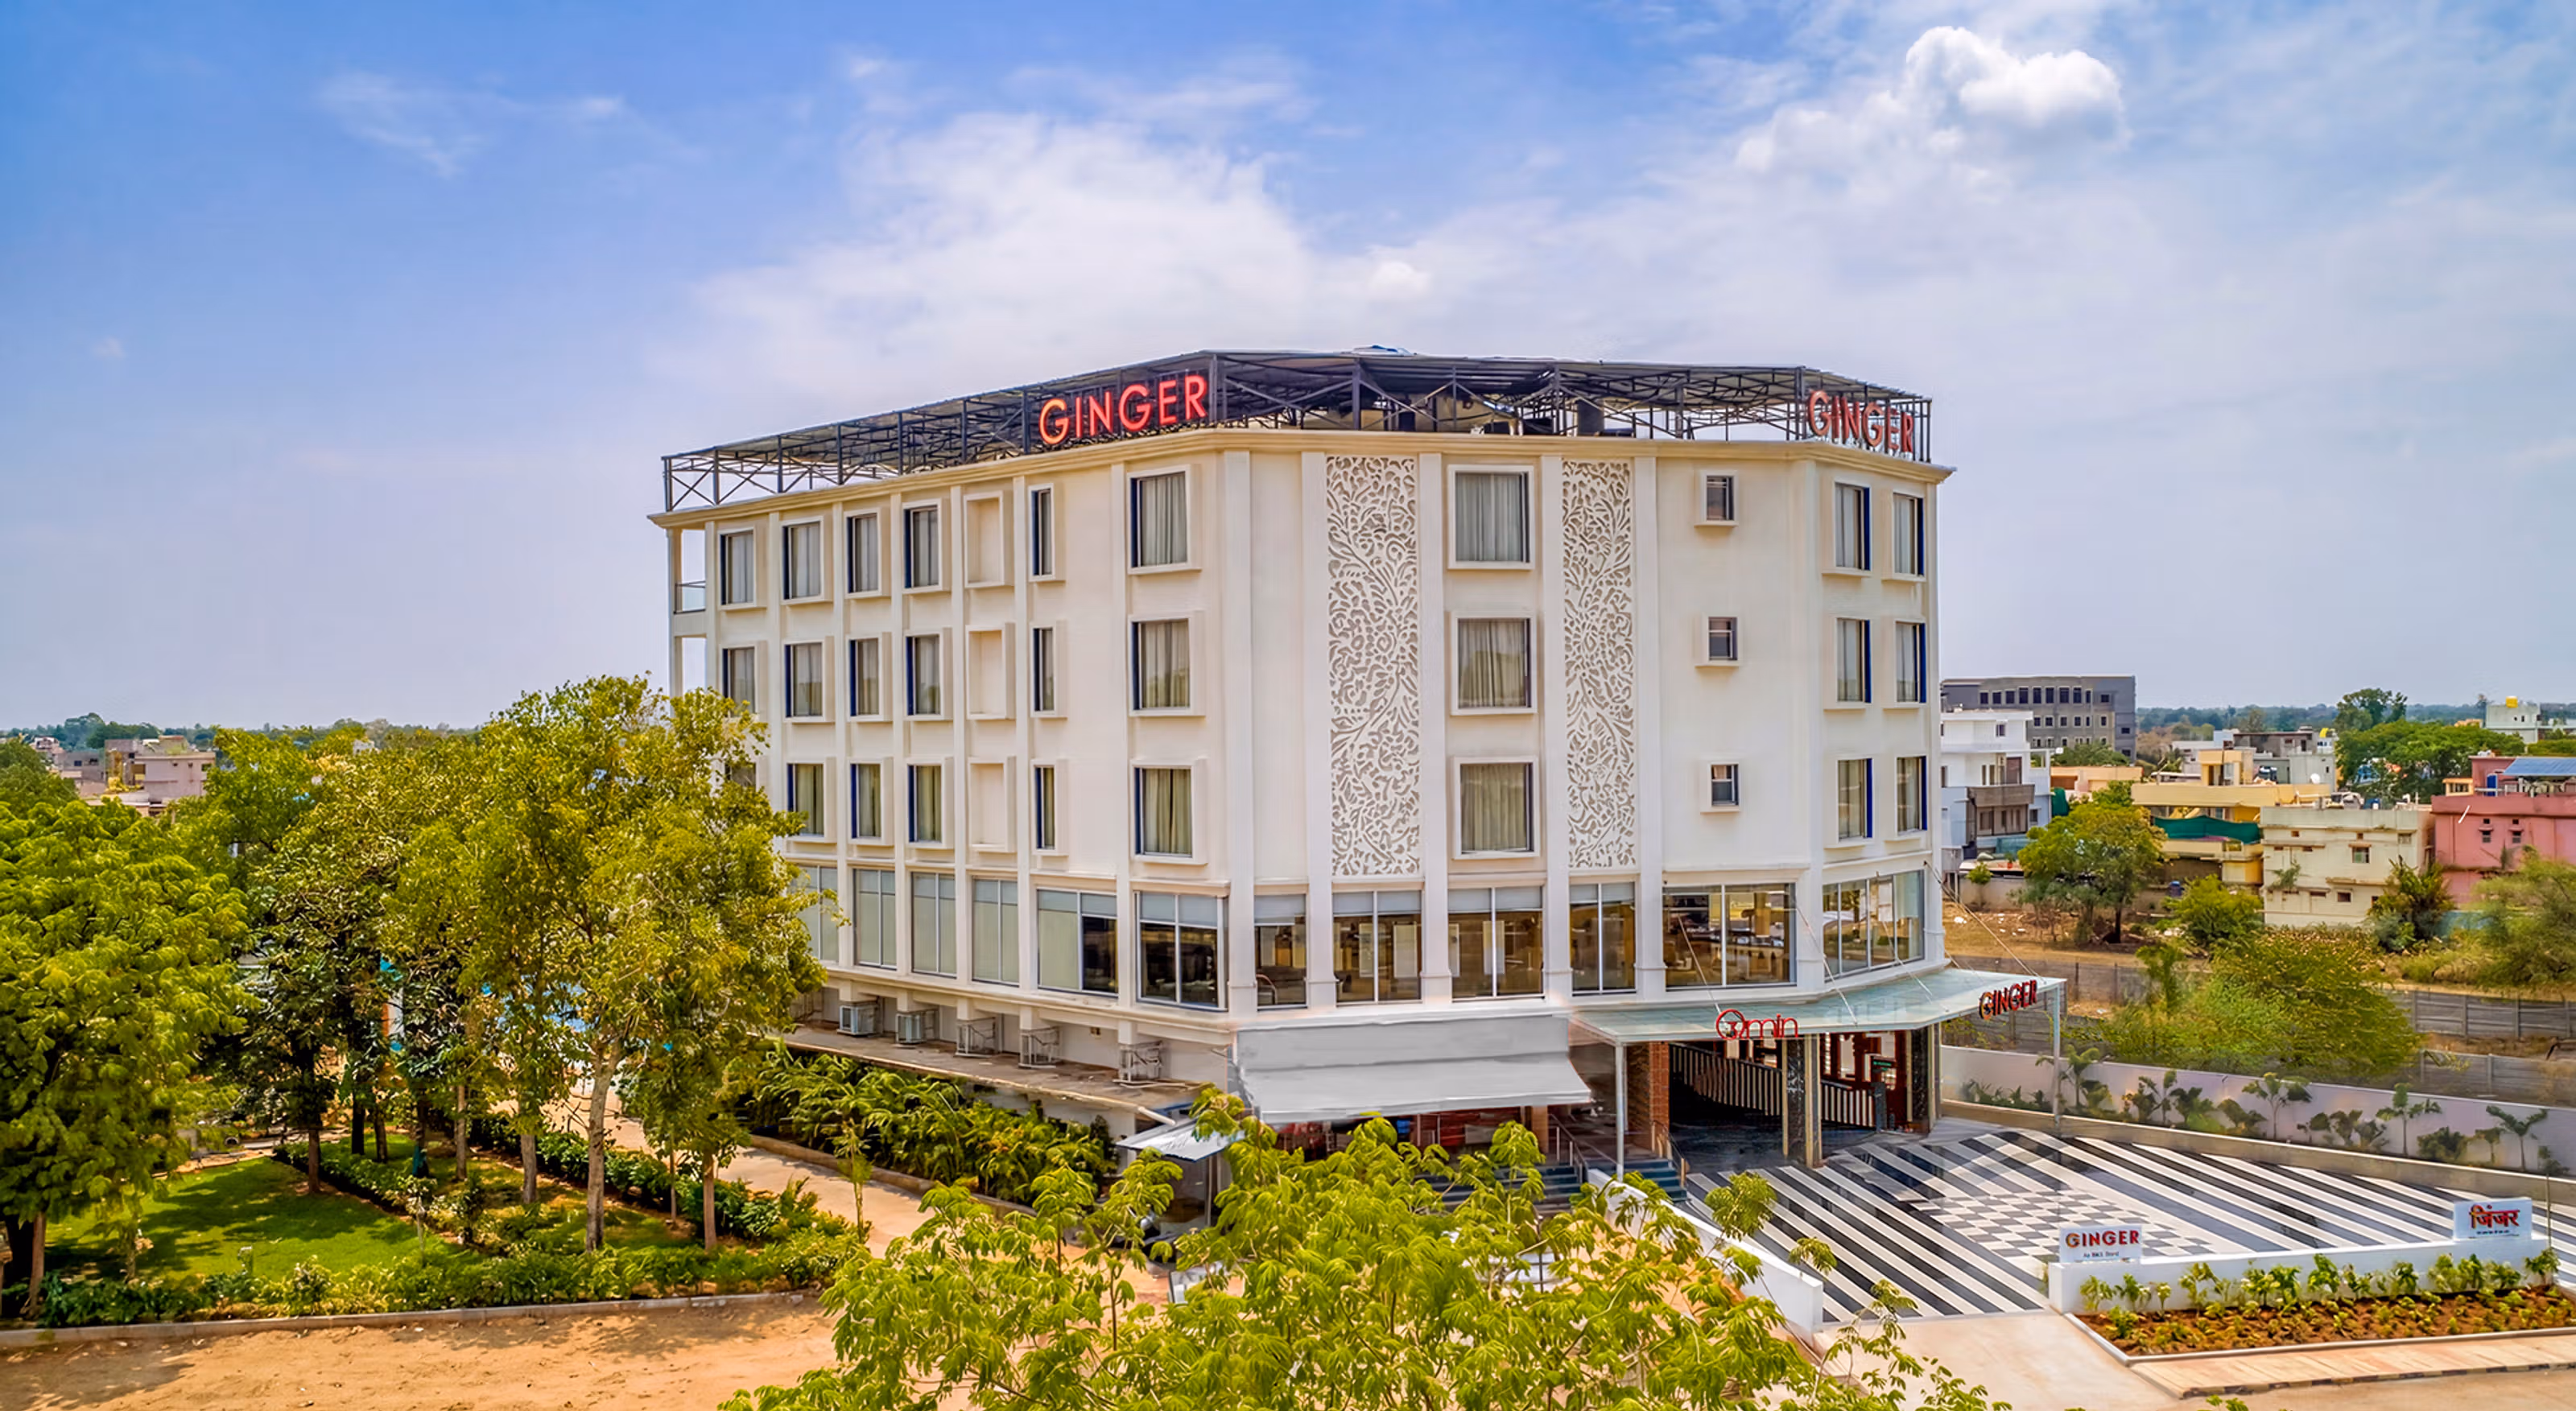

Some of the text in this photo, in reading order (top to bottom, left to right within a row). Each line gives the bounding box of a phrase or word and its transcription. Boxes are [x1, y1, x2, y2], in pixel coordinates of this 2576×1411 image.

[1040, 375, 1207, 444] GINGER
[1808, 390, 1913, 452] GINGER
[1979, 980, 2037, 1020] GINGER
[2469, 1205, 2520, 1228] जिंजर
[2066, 1230, 2140, 1248] GINGER
